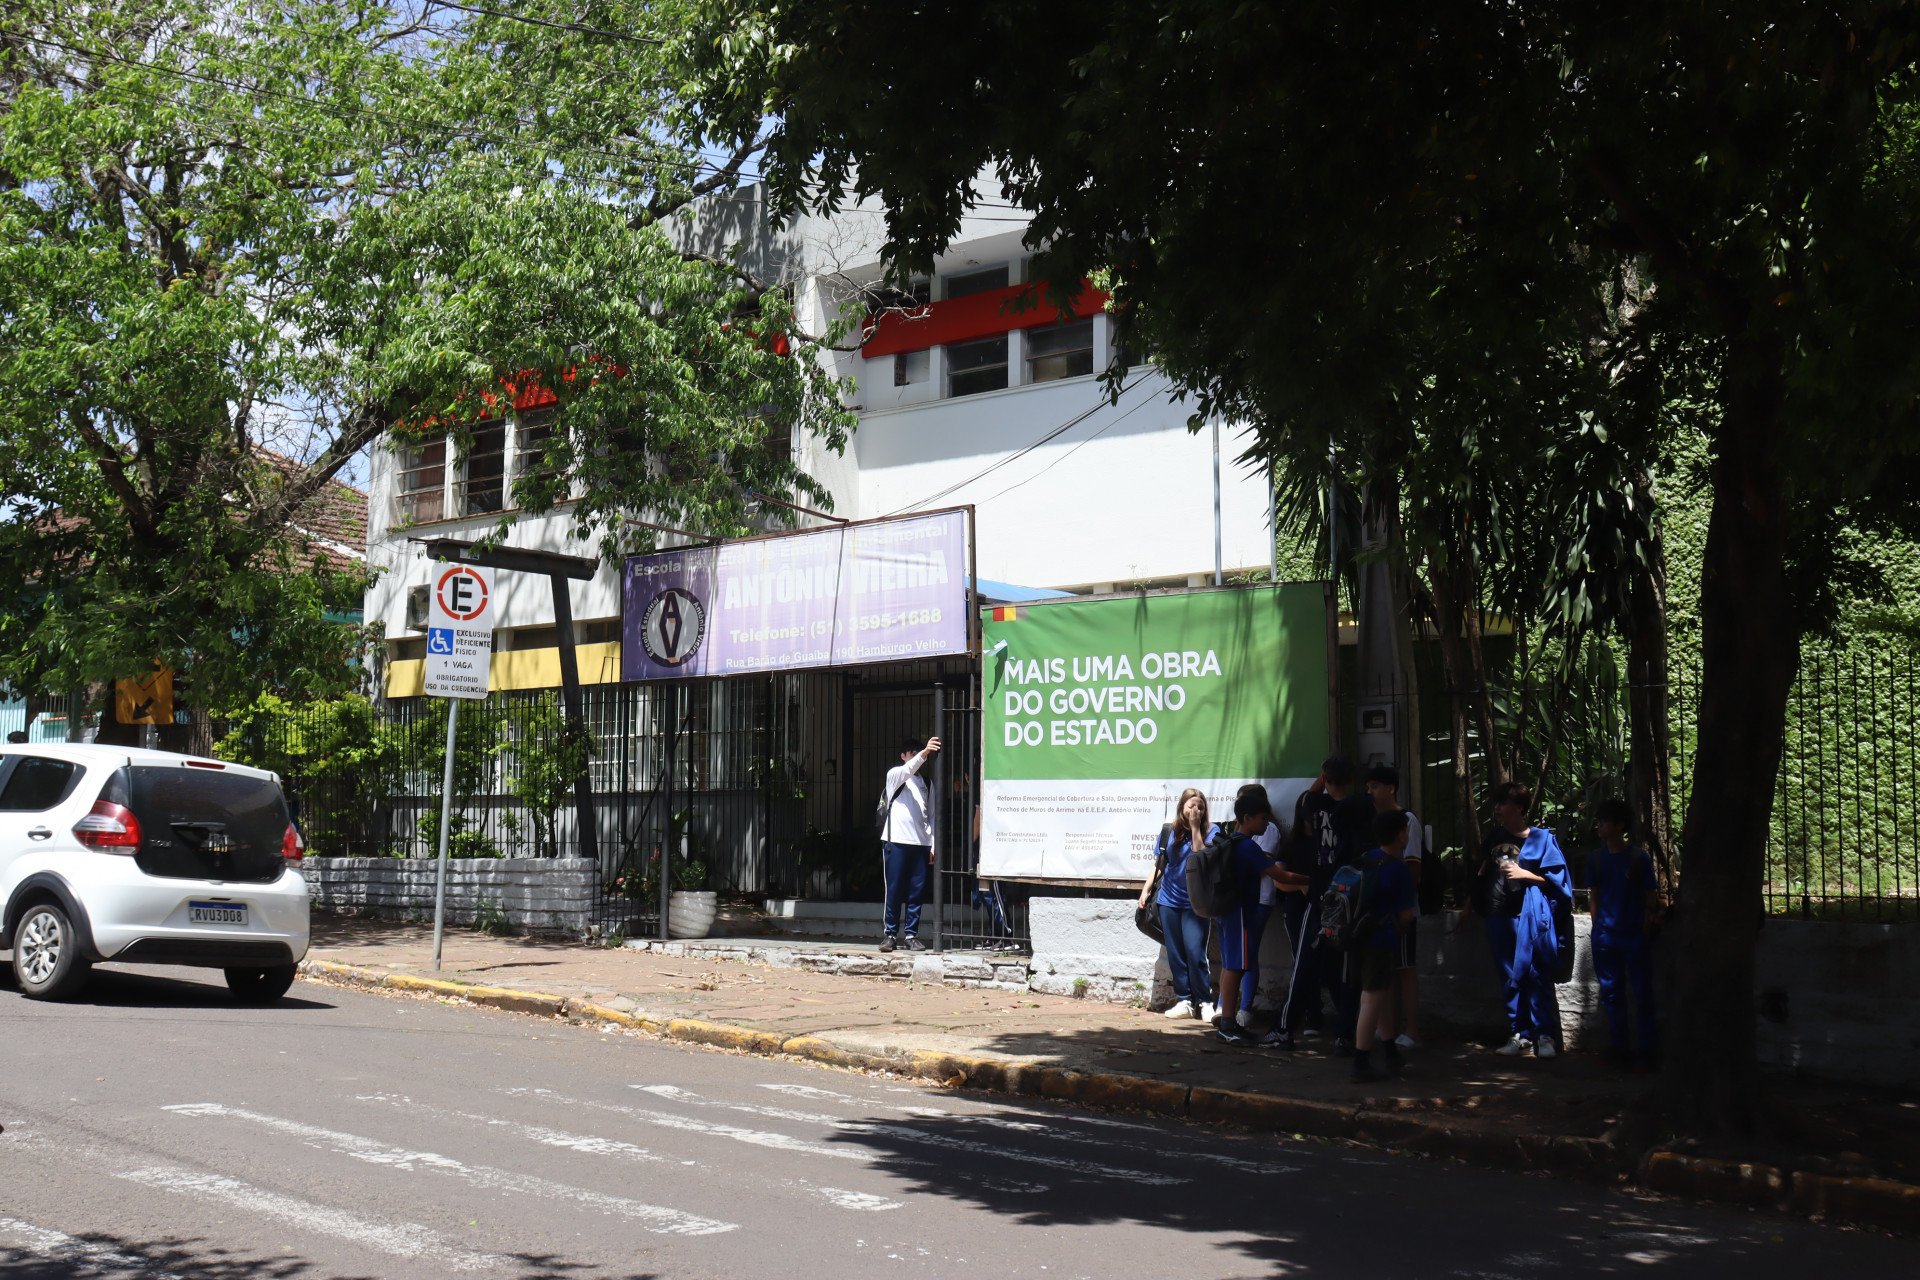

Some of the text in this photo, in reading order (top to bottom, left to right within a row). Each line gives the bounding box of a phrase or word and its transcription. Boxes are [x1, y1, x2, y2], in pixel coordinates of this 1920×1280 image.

[634, 560, 681, 577] Escola
[724, 550, 949, 609] ANTÔNIO VIEIRA
[452, 576, 473, 612] E
[730, 624, 805, 644] Telefone:
[849, 607, 942, 631] 3595-1688
[456, 629, 491, 639] EXCLUSIVO
[456, 638, 491, 648] DEFICIENTE
[726, 658, 745, 668] Rua
[780, 653, 791, 663] de
[836, 647, 853, 658] 190
[857, 643, 912, 657] Hamburgo
[915, 639, 947, 651] Velho
[443, 660, 473, 669] 1 VAGA
[1004, 650, 1222, 685] MAIS UMA OBRA
[436, 674, 479, 684] OBRIGATORIO
[451, 685, 488, 694] CREDENCIAL
[1005, 684, 1186, 716] DO GOVERNO
[1004, 718, 1158, 746] DO ESTADO
[1023, 795, 1057, 803] Emergencial
[1117, 795, 1148, 803] Drenagem
[1131, 833, 1161, 841] INVEST
[1131, 843, 1155, 851] TOTAL
[1130, 853, 1141, 861] R$
[195, 908, 242, 923] RVU3D08
